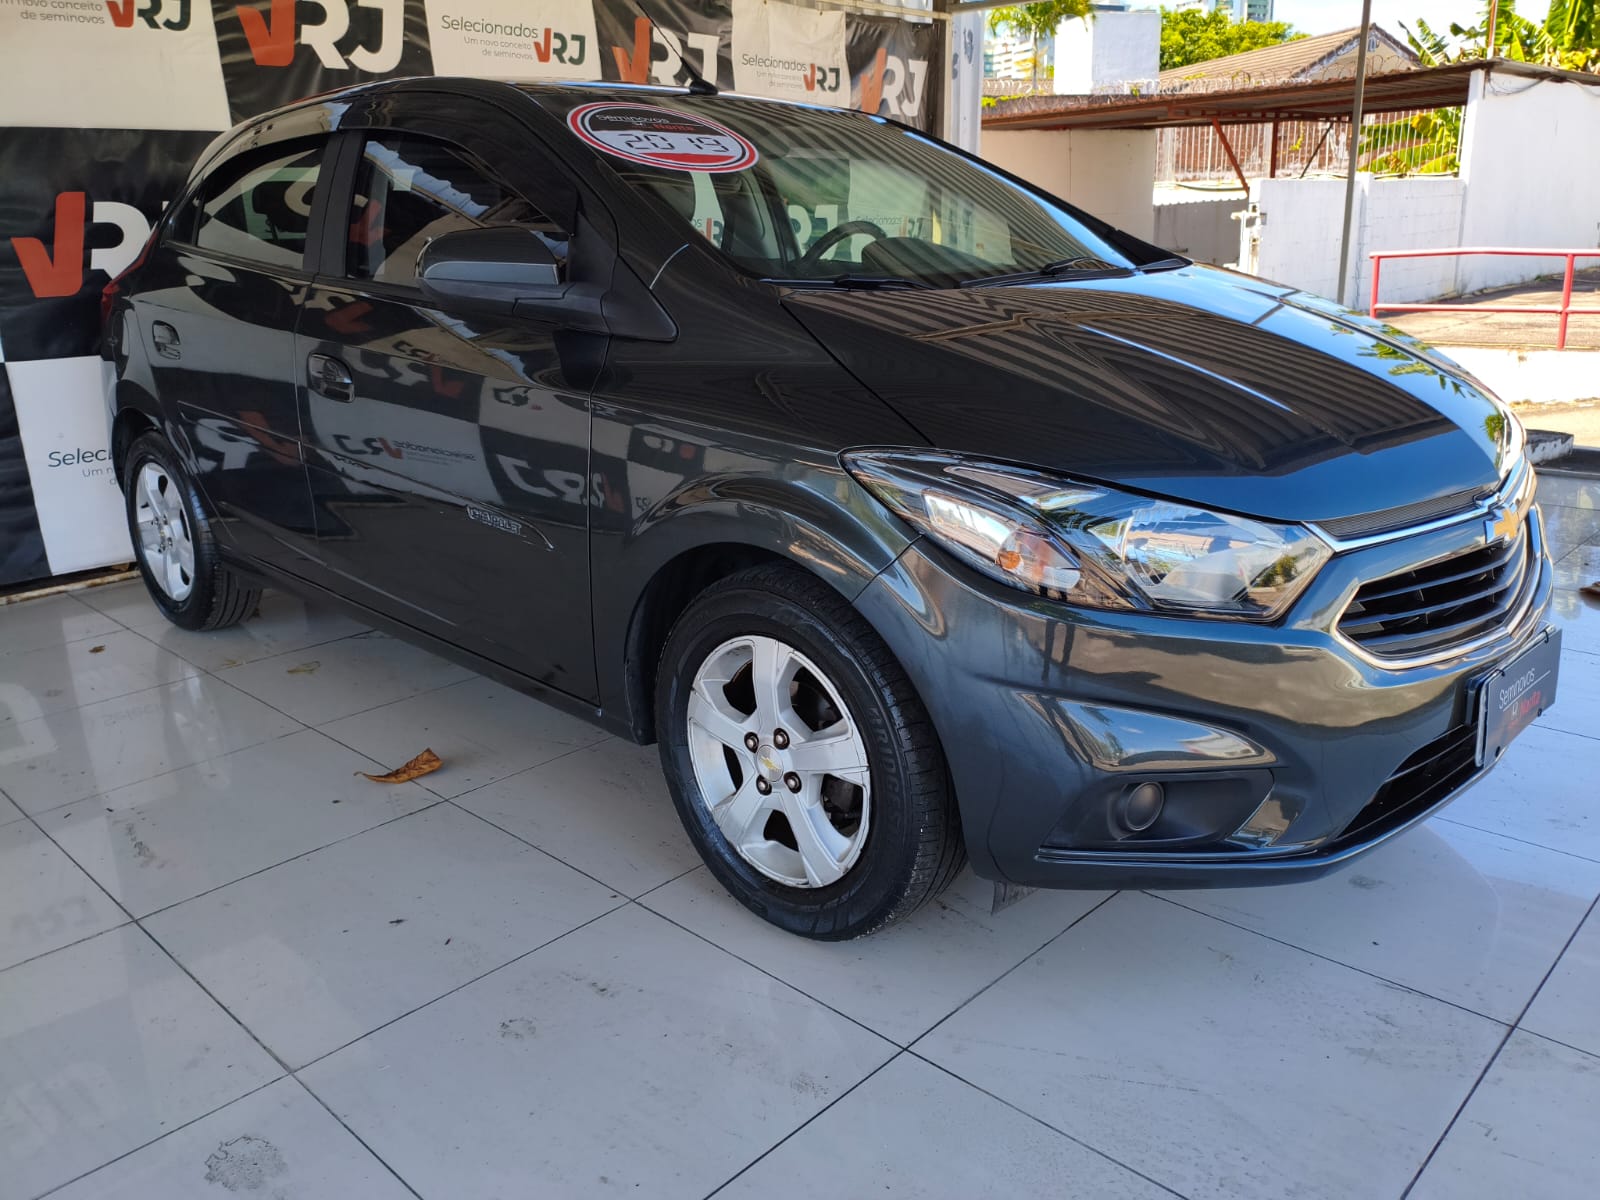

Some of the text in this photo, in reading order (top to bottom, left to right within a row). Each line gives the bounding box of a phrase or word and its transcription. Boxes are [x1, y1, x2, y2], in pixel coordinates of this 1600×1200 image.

[20, 10, 105, 24] de seminovos
[51, 0, 103, 11] conceito
[105, 0, 191, 31] VRJ
[236, 0, 403, 73] VRJ
[441, 15, 538, 38] Selecionados
[464, 37, 479, 45] Um
[500, 41, 532, 50] conceito
[493, 51, 533, 60] seminovos
[533, 28, 586, 65] VRJ
[612, 17, 721, 86] VRJ
[742, 54, 807, 72] Selecionados
[803, 63, 840, 92] VRJ
[860, 48, 929, 117] VRJ
[10, 191, 160, 298] VR
[47, 448, 112, 468] Selec
